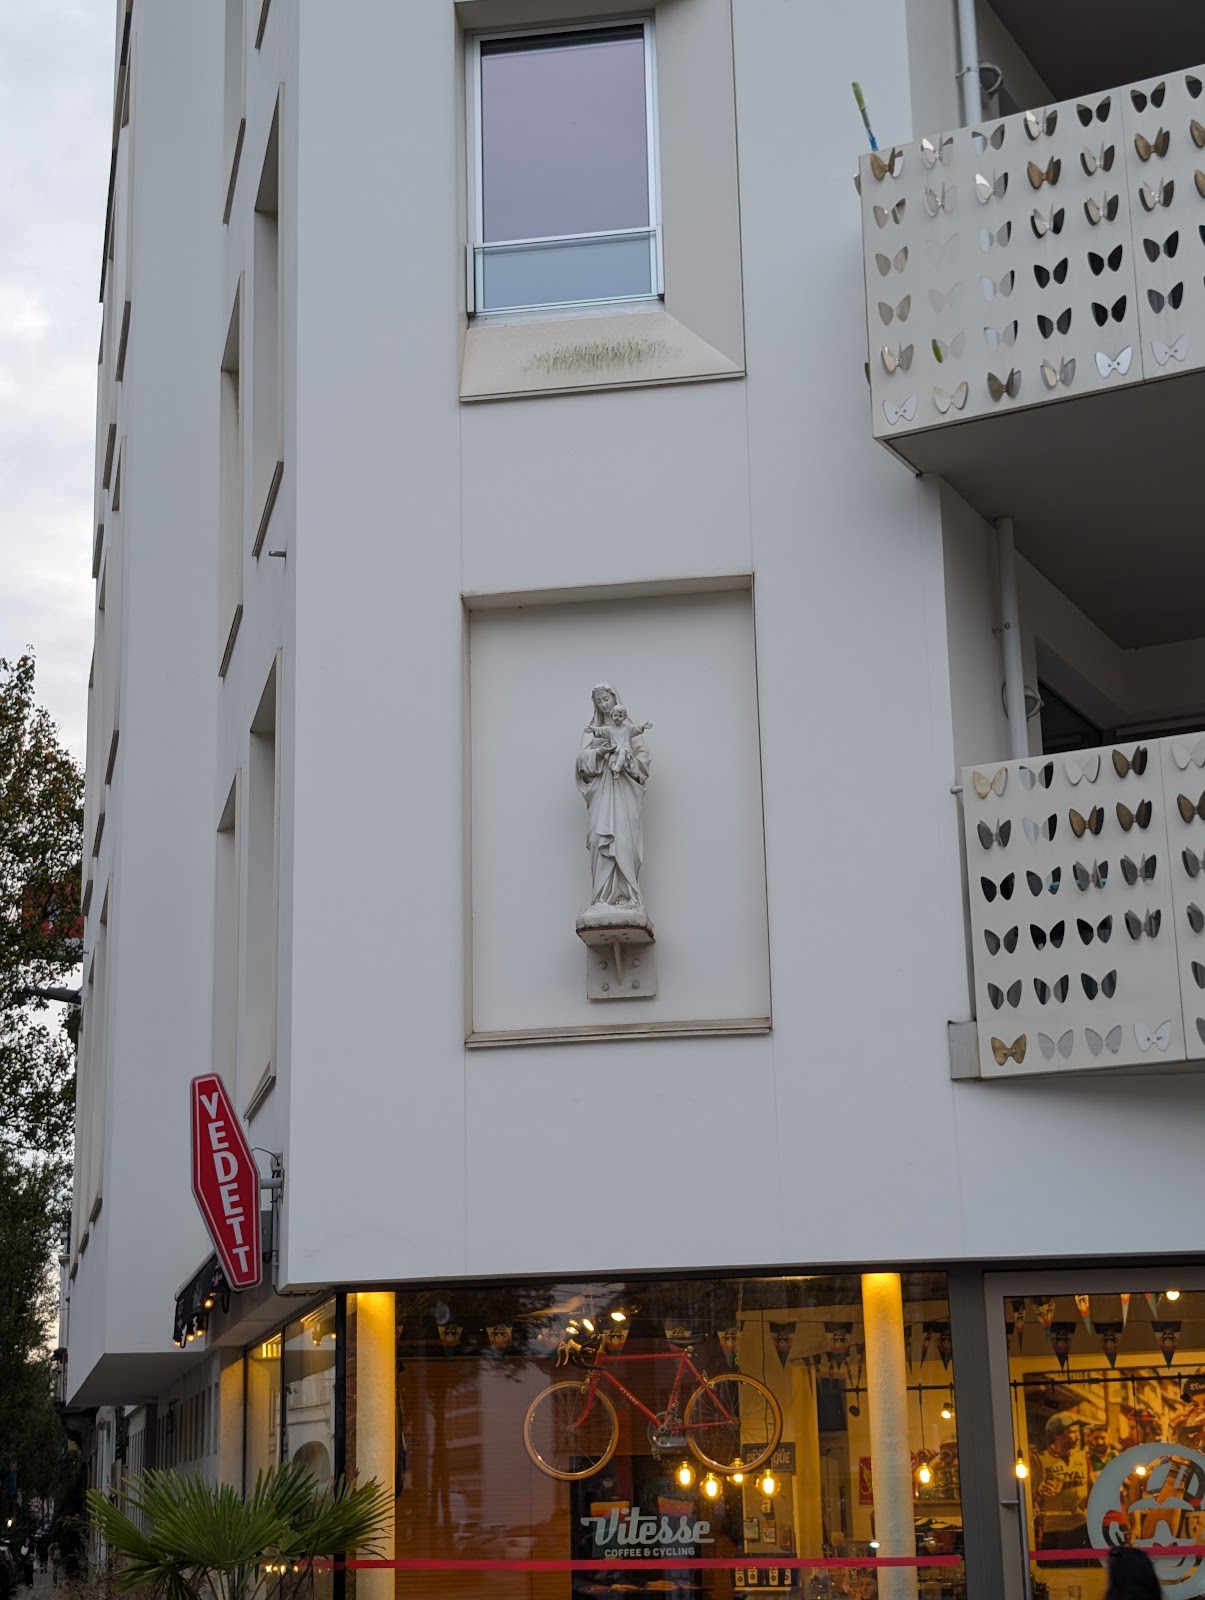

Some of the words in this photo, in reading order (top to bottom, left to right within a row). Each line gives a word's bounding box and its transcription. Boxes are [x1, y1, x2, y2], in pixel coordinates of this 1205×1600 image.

[200, 1091, 250, 1273] VEDETT
[580, 1506, 715, 1546] Vitesse
[604, 1548, 642, 1558] COFFEE
[643, 1548, 651, 1557] &
[652, 1547, 695, 1557] CYCLING
